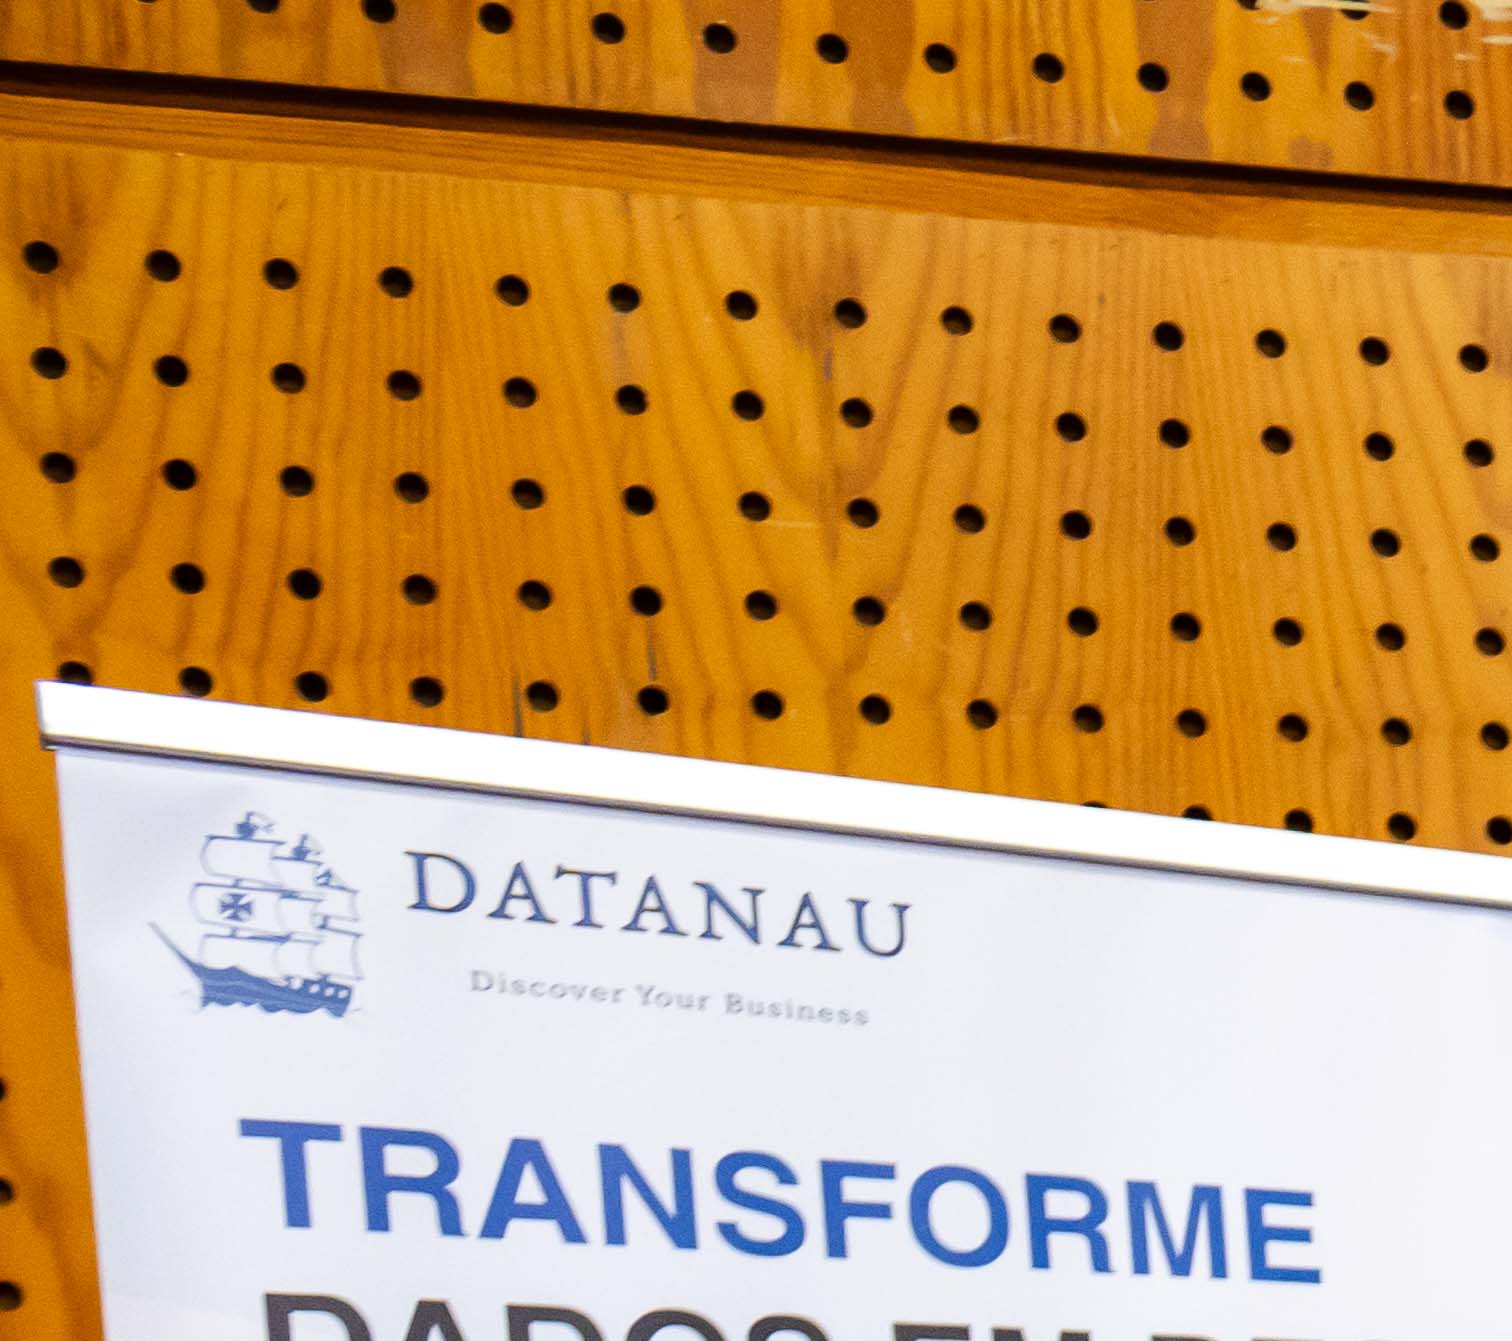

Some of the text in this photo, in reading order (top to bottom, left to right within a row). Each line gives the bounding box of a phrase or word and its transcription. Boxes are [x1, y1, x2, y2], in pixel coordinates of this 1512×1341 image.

[404, 850, 912, 960] DATANAU
[470, 969, 870, 1028] Discover Your Business
[239, 1118, 1322, 1285] TRANSFORME
